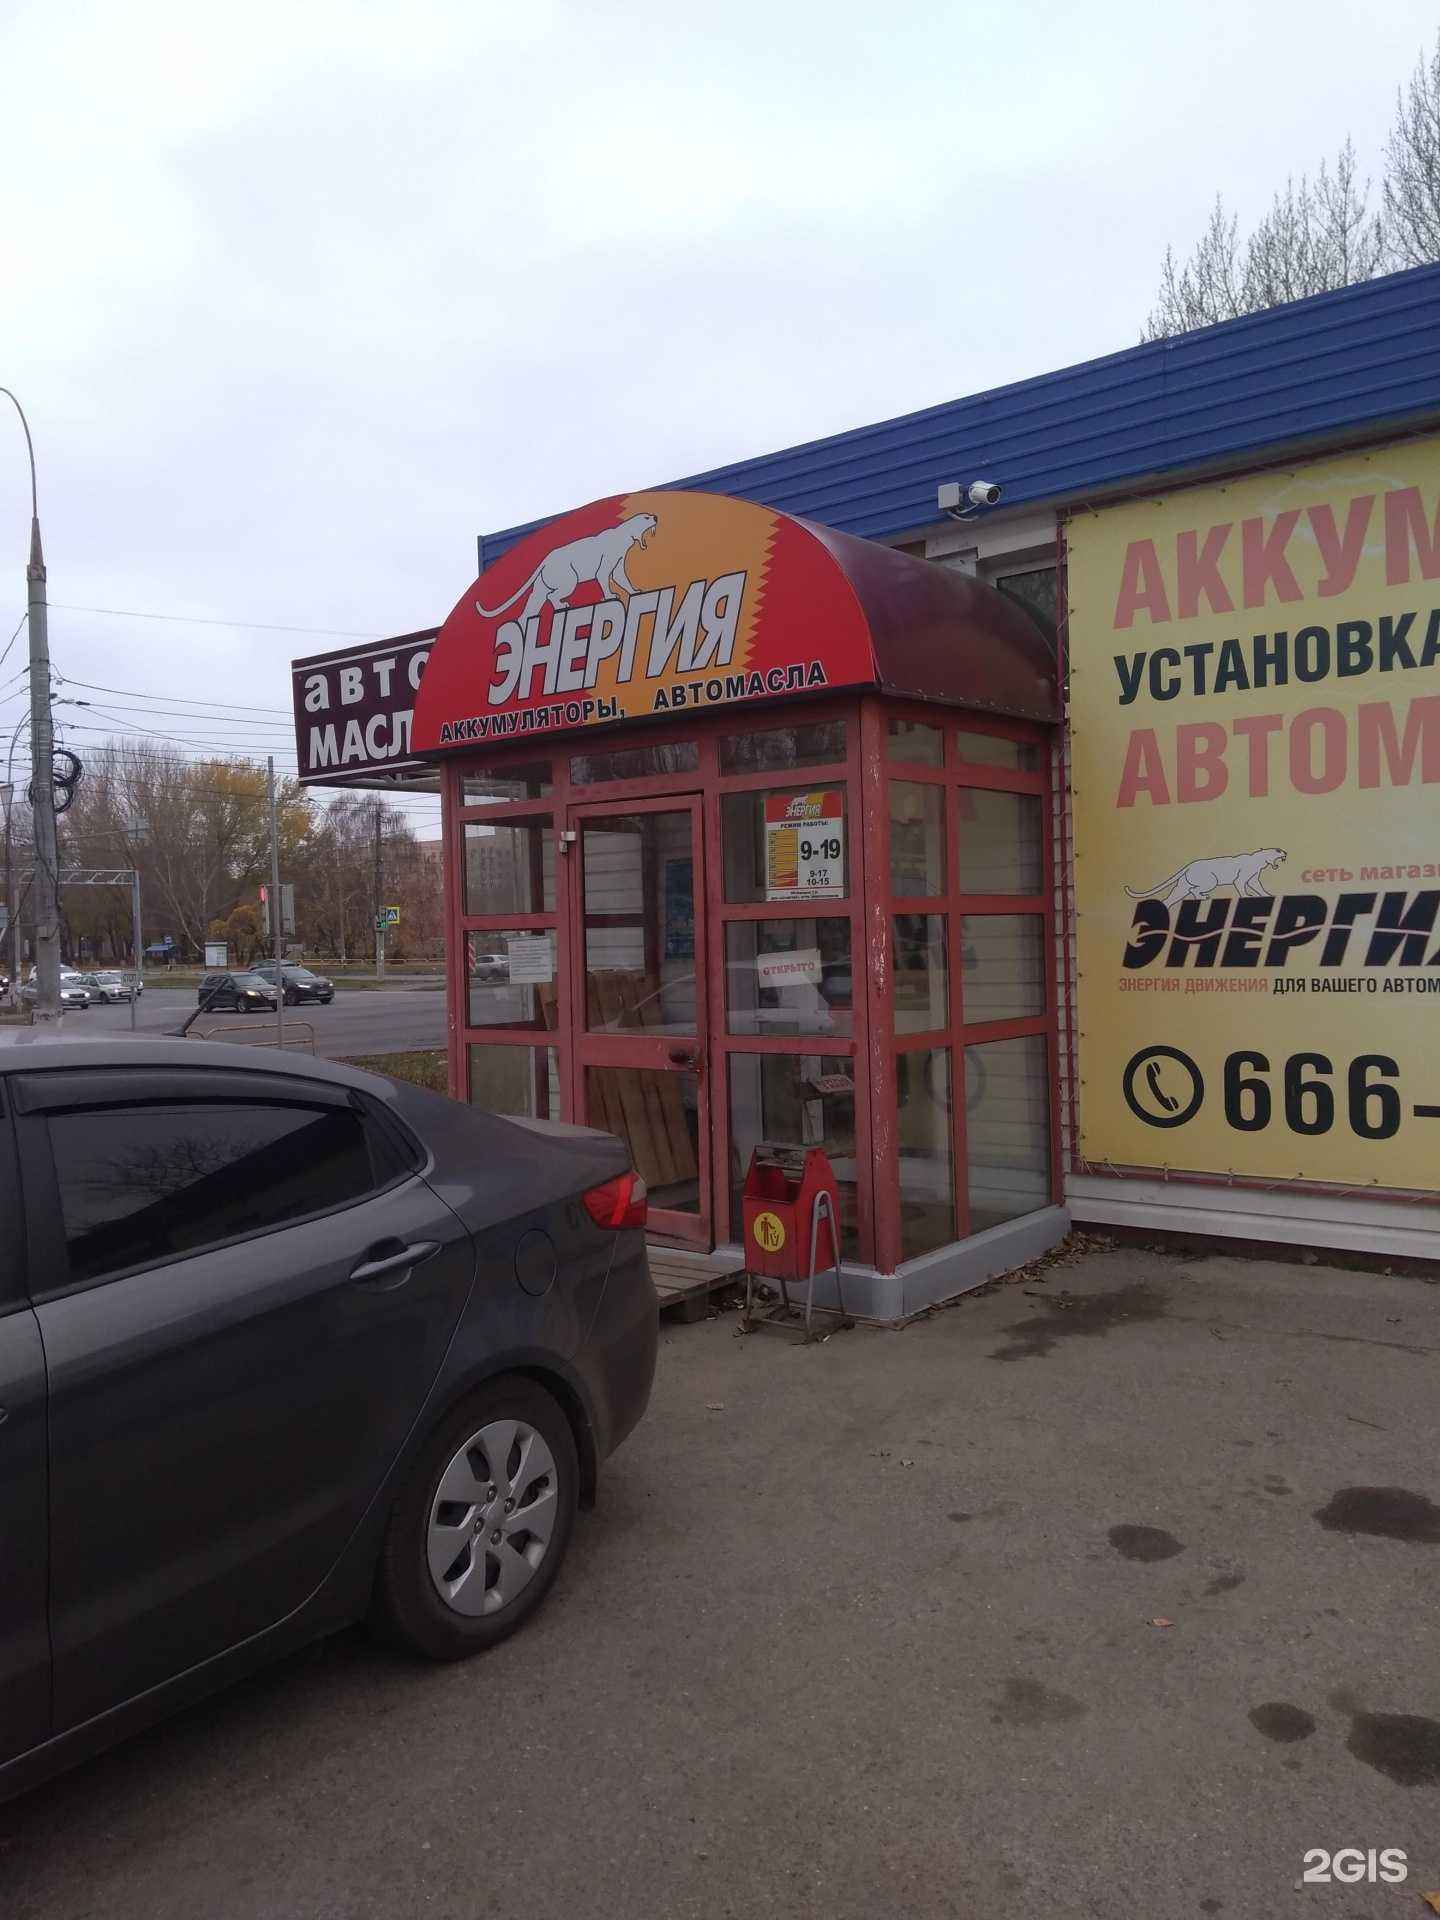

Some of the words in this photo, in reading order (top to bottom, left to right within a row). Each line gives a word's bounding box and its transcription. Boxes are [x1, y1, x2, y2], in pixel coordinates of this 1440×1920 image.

[487, 571, 747, 706] ЭНЕРГИЯ
[439, 696, 625, 743] АККУМУЛЯТОРЫ,
[652, 660, 829, 711] АВТОМАСЛА
[1116, 695, 1440, 808] АВТОМ
[800, 838, 841, 861] 9-19
[806, 877, 830, 886] 10-15
[810, 869, 829, 878] 9-17
[1301, 867, 1354, 884] сеть
[1360, 862, 1440, 881] магаз
[1122, 889, 1440, 969] ЭНЕРГИ
[762, 960, 816, 977] ОТКРЫТО
[1119, 977, 1180, 992] ЭНЕРГИЯ
[1184, 977, 1268, 994] ДВИЖЕНИЯ
[1273, 977, 1306, 995] ДЛЯ
[1311, 978, 1377, 993] ВАШЕГО
